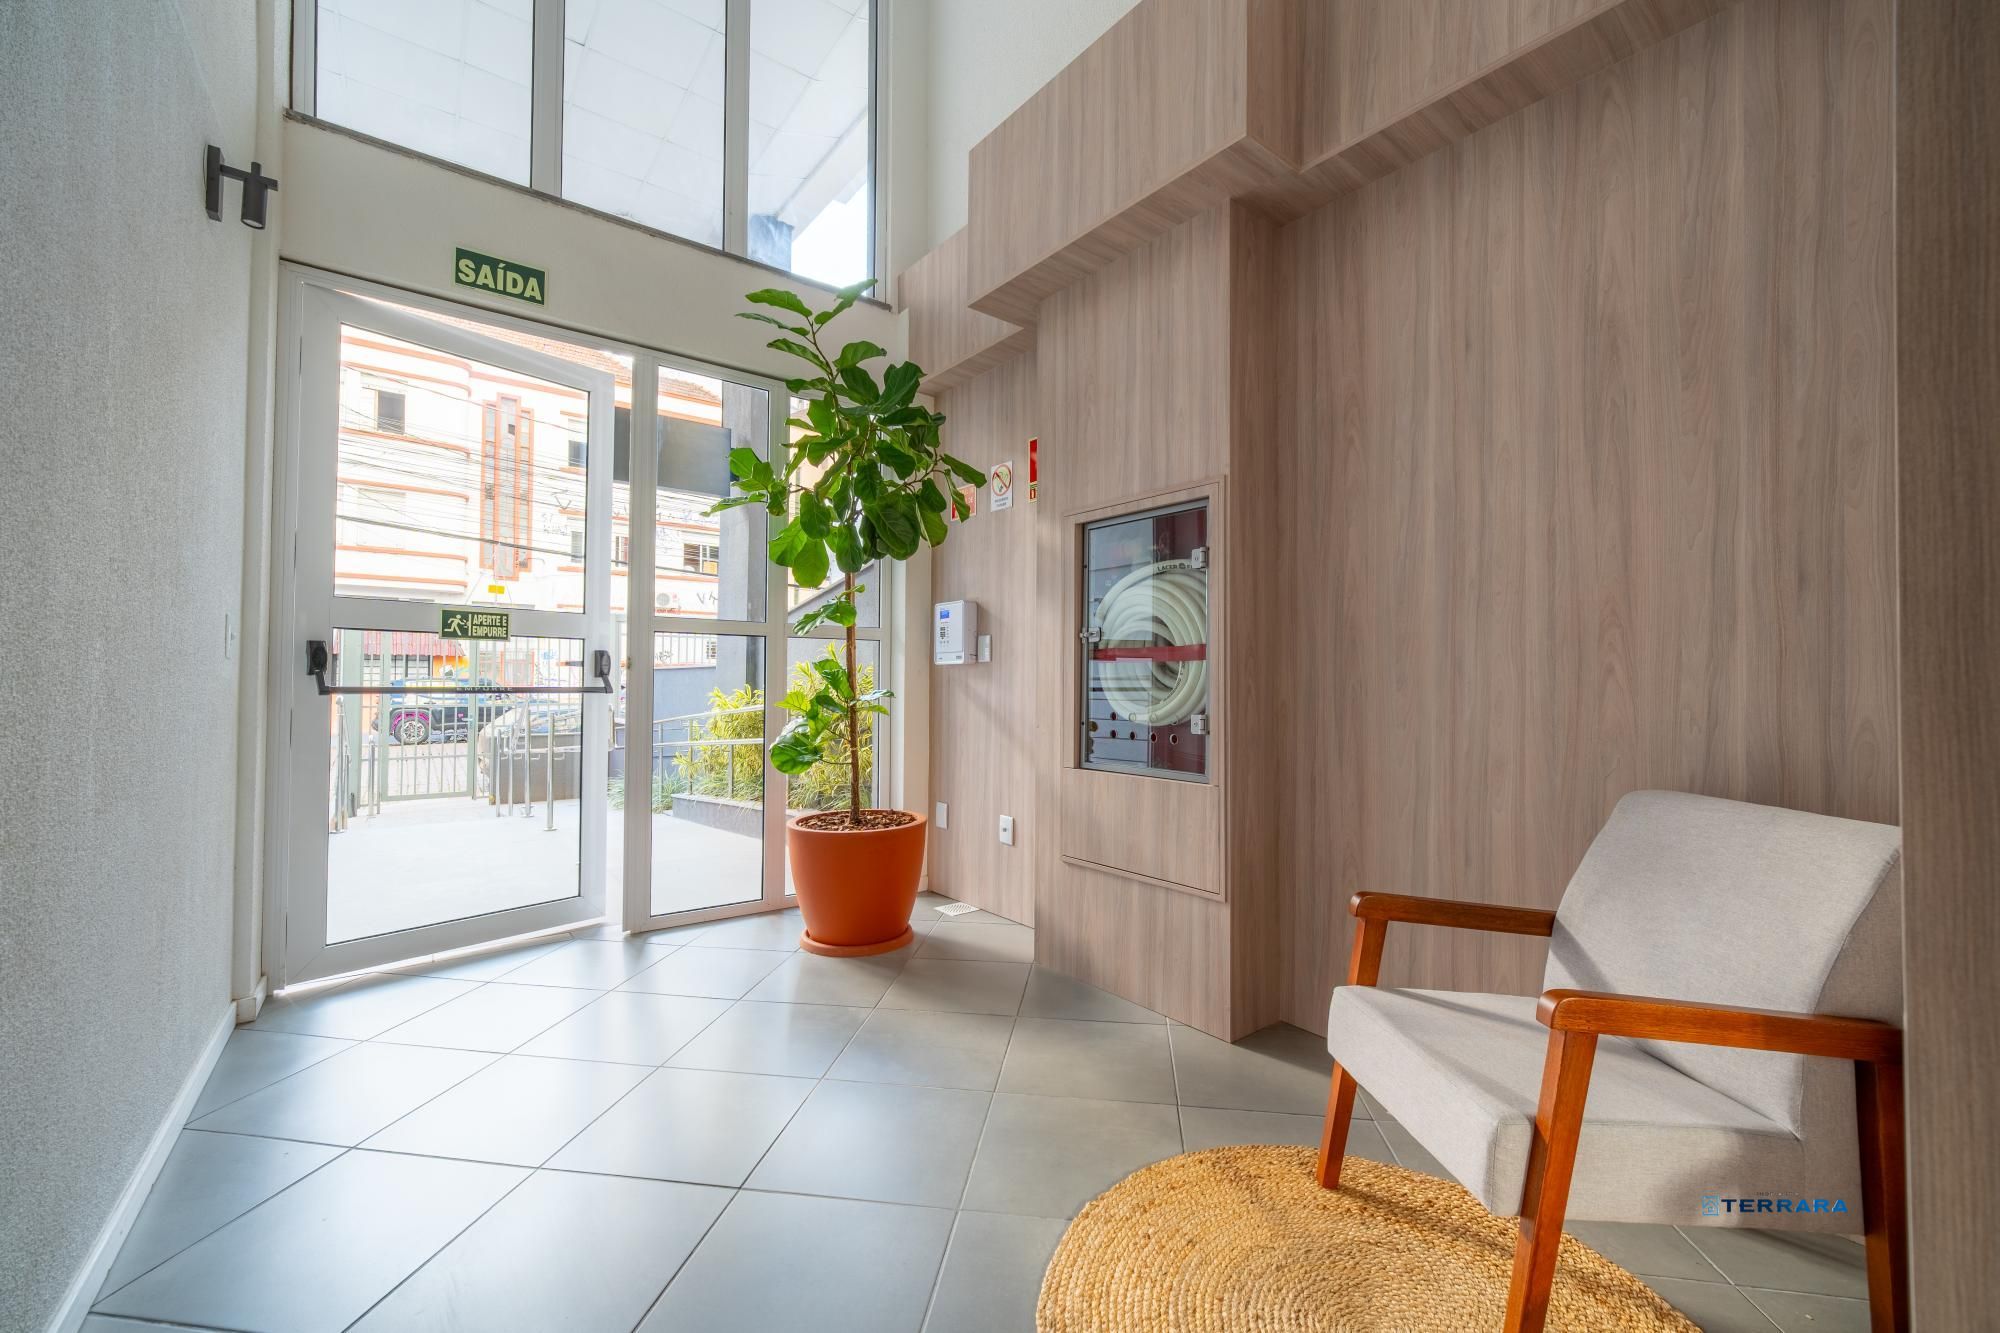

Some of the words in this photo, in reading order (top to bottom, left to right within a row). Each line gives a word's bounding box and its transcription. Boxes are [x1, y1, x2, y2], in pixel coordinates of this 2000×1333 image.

[457, 258, 542, 301] SAÍDA
[473, 614, 501, 626] APERTE
[502, 615, 507, 627] E
[472, 626, 507, 637] EMPURRE
